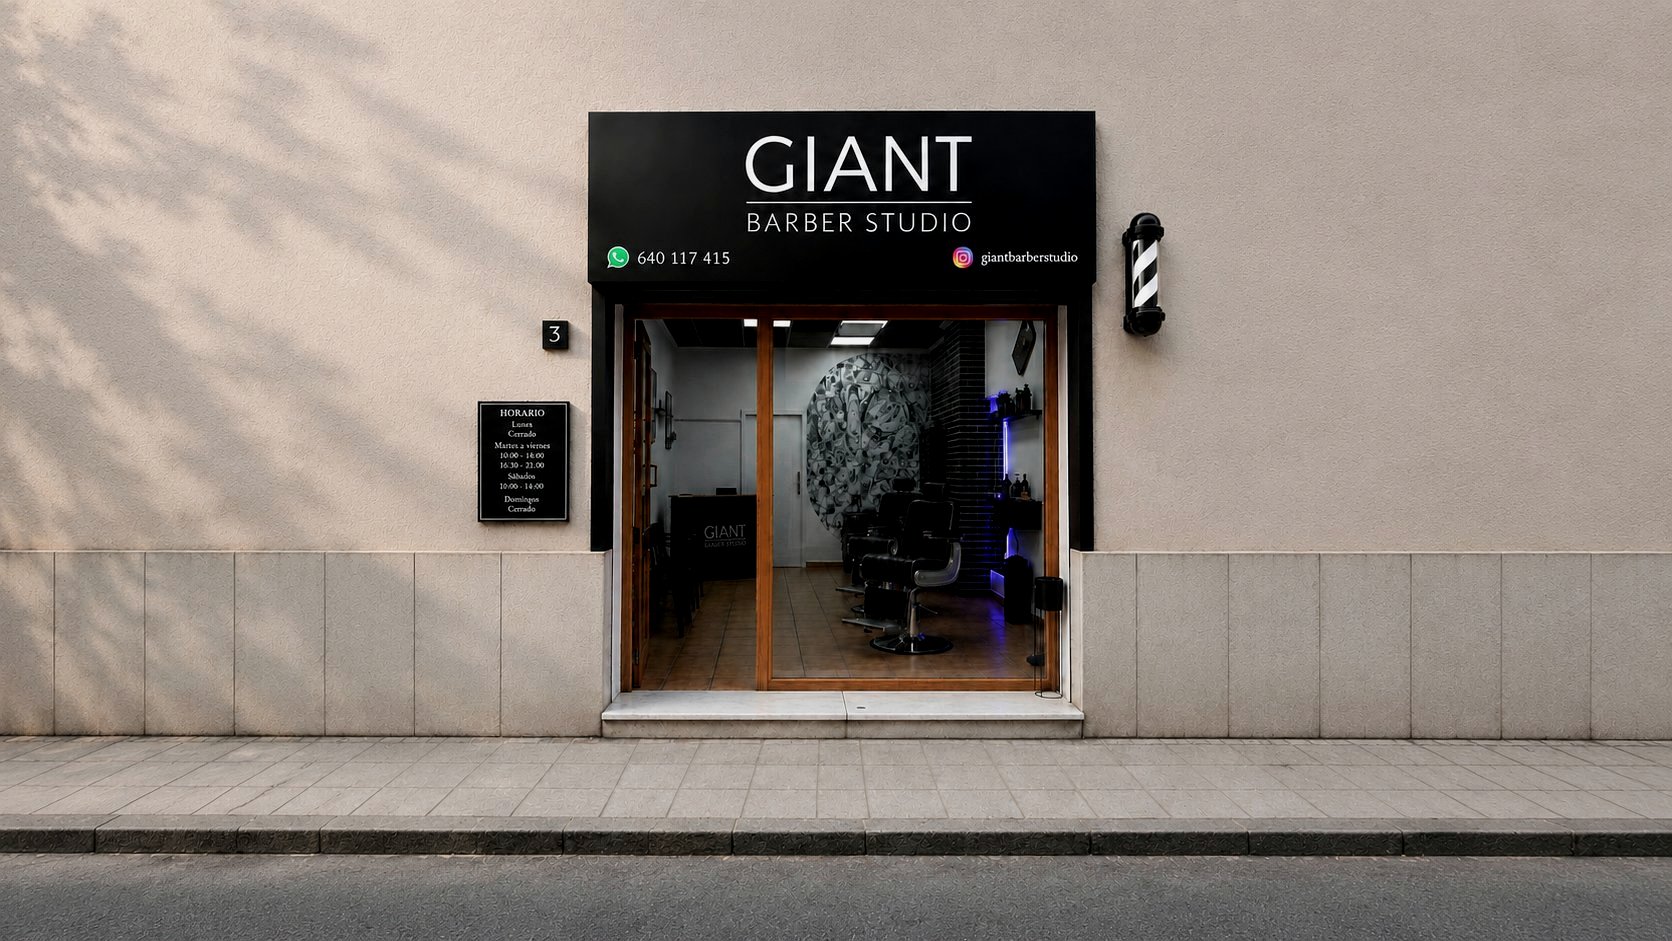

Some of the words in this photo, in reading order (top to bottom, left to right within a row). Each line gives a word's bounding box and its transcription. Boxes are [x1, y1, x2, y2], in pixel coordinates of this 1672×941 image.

[745, 135, 973, 194] GIANT
[747, 212, 853, 233] BARBER
[866, 212, 972, 233] STUDIO
[637, 250, 666, 265] 640
[671, 250, 698, 265] 117
[703, 250, 730, 265] 415
[980, 250, 1079, 267] giantbarberstudio
[549, 325, 561, 343] 3
[500, 409, 545, 417] HORARIO
[508, 430, 537, 438] Cerrado
[494, 441, 519, 449] Martes
[526, 441, 551, 449] viernes
[507, 505, 536, 513] Cerrado
[704, 524, 747, 539] GIANT
